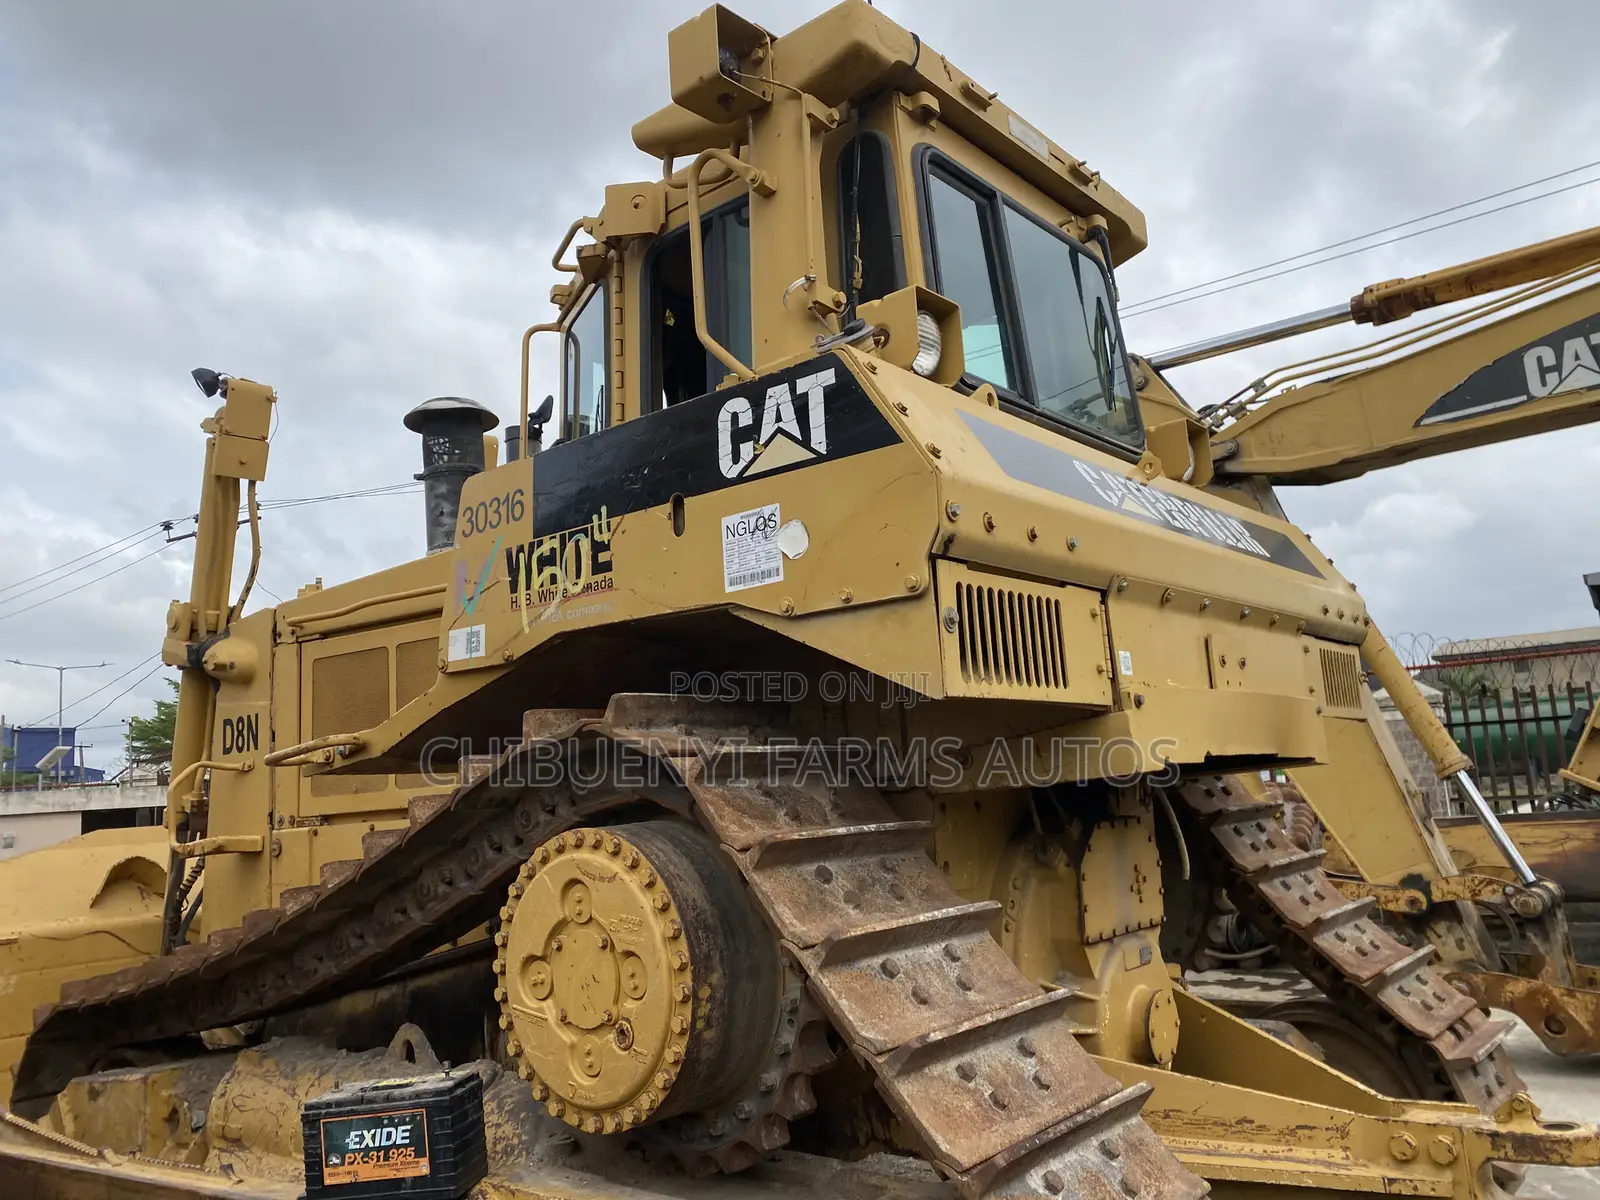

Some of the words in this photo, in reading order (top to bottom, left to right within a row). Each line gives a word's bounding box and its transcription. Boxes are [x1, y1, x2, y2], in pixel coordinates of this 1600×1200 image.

[1523, 332, 1600, 398] CA
[718, 367, 836, 479] CAT
[462, 488, 525, 538] 30316
[726, 512, 777, 540] NGLOS
[505, 519, 613, 594] WHITE
[538, 587, 568, 604] Whie
[222, 713, 259, 755] D8N
[344, 1149, 385, 1167] PX-31
[388, 1146, 415, 1161] 925
[347, 1124, 411, 1150] EXIDE
